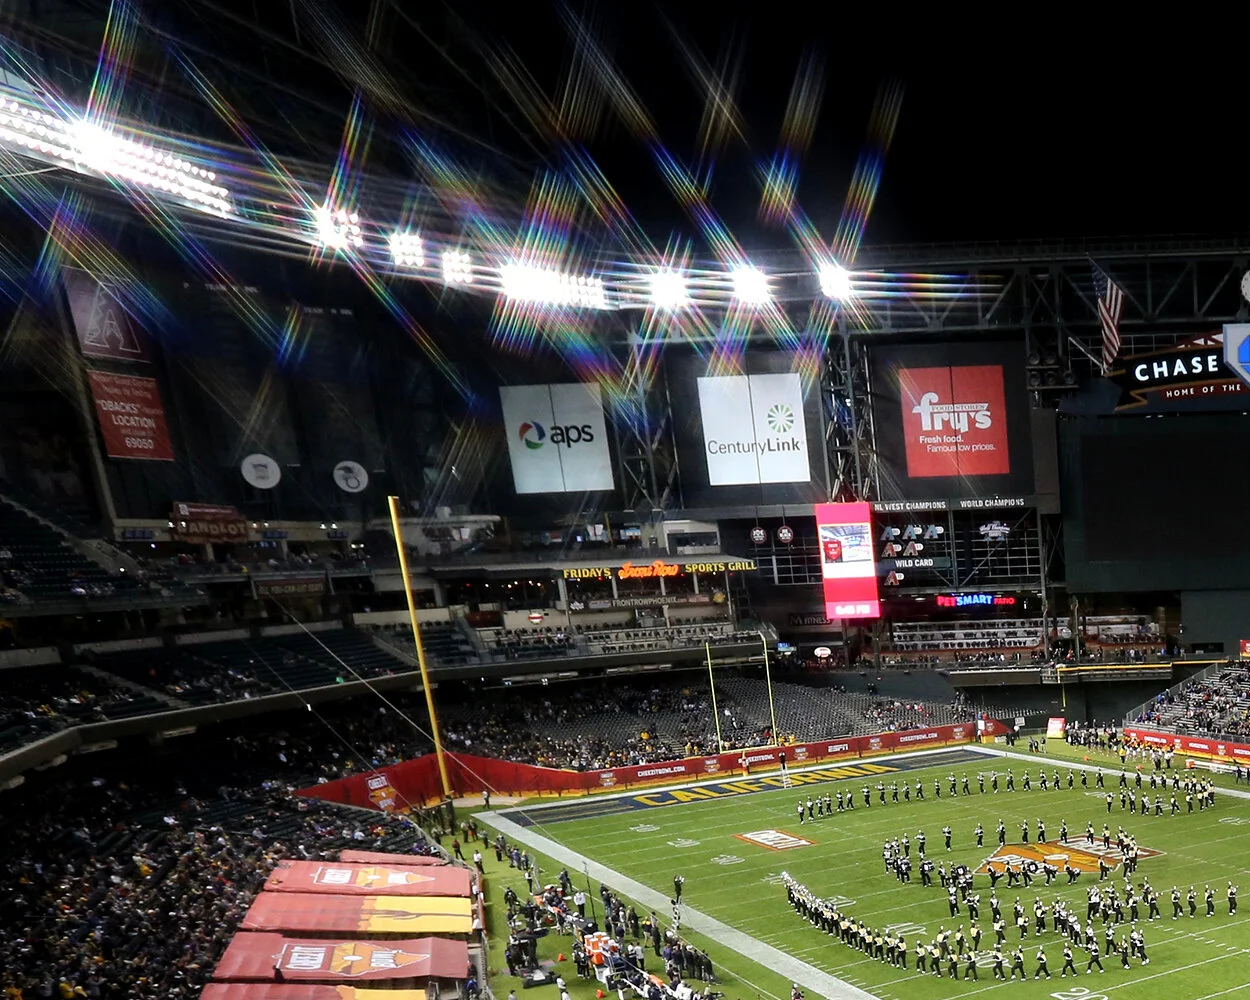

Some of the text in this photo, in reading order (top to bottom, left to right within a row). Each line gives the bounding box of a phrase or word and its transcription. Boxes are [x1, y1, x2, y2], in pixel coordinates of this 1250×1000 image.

[1134, 355, 1219, 382] CHASE
[1166, 387, 1195, 398] HOME
[1202, 386, 1215, 394] OF
[1222, 383, 1241, 391] THE
[912, 392, 992, 433] fry's
[111, 414, 156, 429] LOCATION
[550, 423, 594, 448] aps
[919, 434, 964, 444] Fresh food.
[708, 437, 801, 455] CenturyLink
[927, 443, 996, 453] Famous low prices.
[874, 501, 947, 511] NL WEST CHAMPIONS
[960, 498, 1025, 508] WORLD CHAMPIONS
[563, 568, 612, 579] FRIDAYS
[685, 563, 726, 574] SPORTS
[728, 560, 758, 571] GRILL
[895, 559, 933, 569] WILD CARD
[937, 595, 993, 607] PETSMART
[637, 766, 686, 778] CHEEZITBOWL.COM
[634, 763, 902, 807] CALIFORNIA
